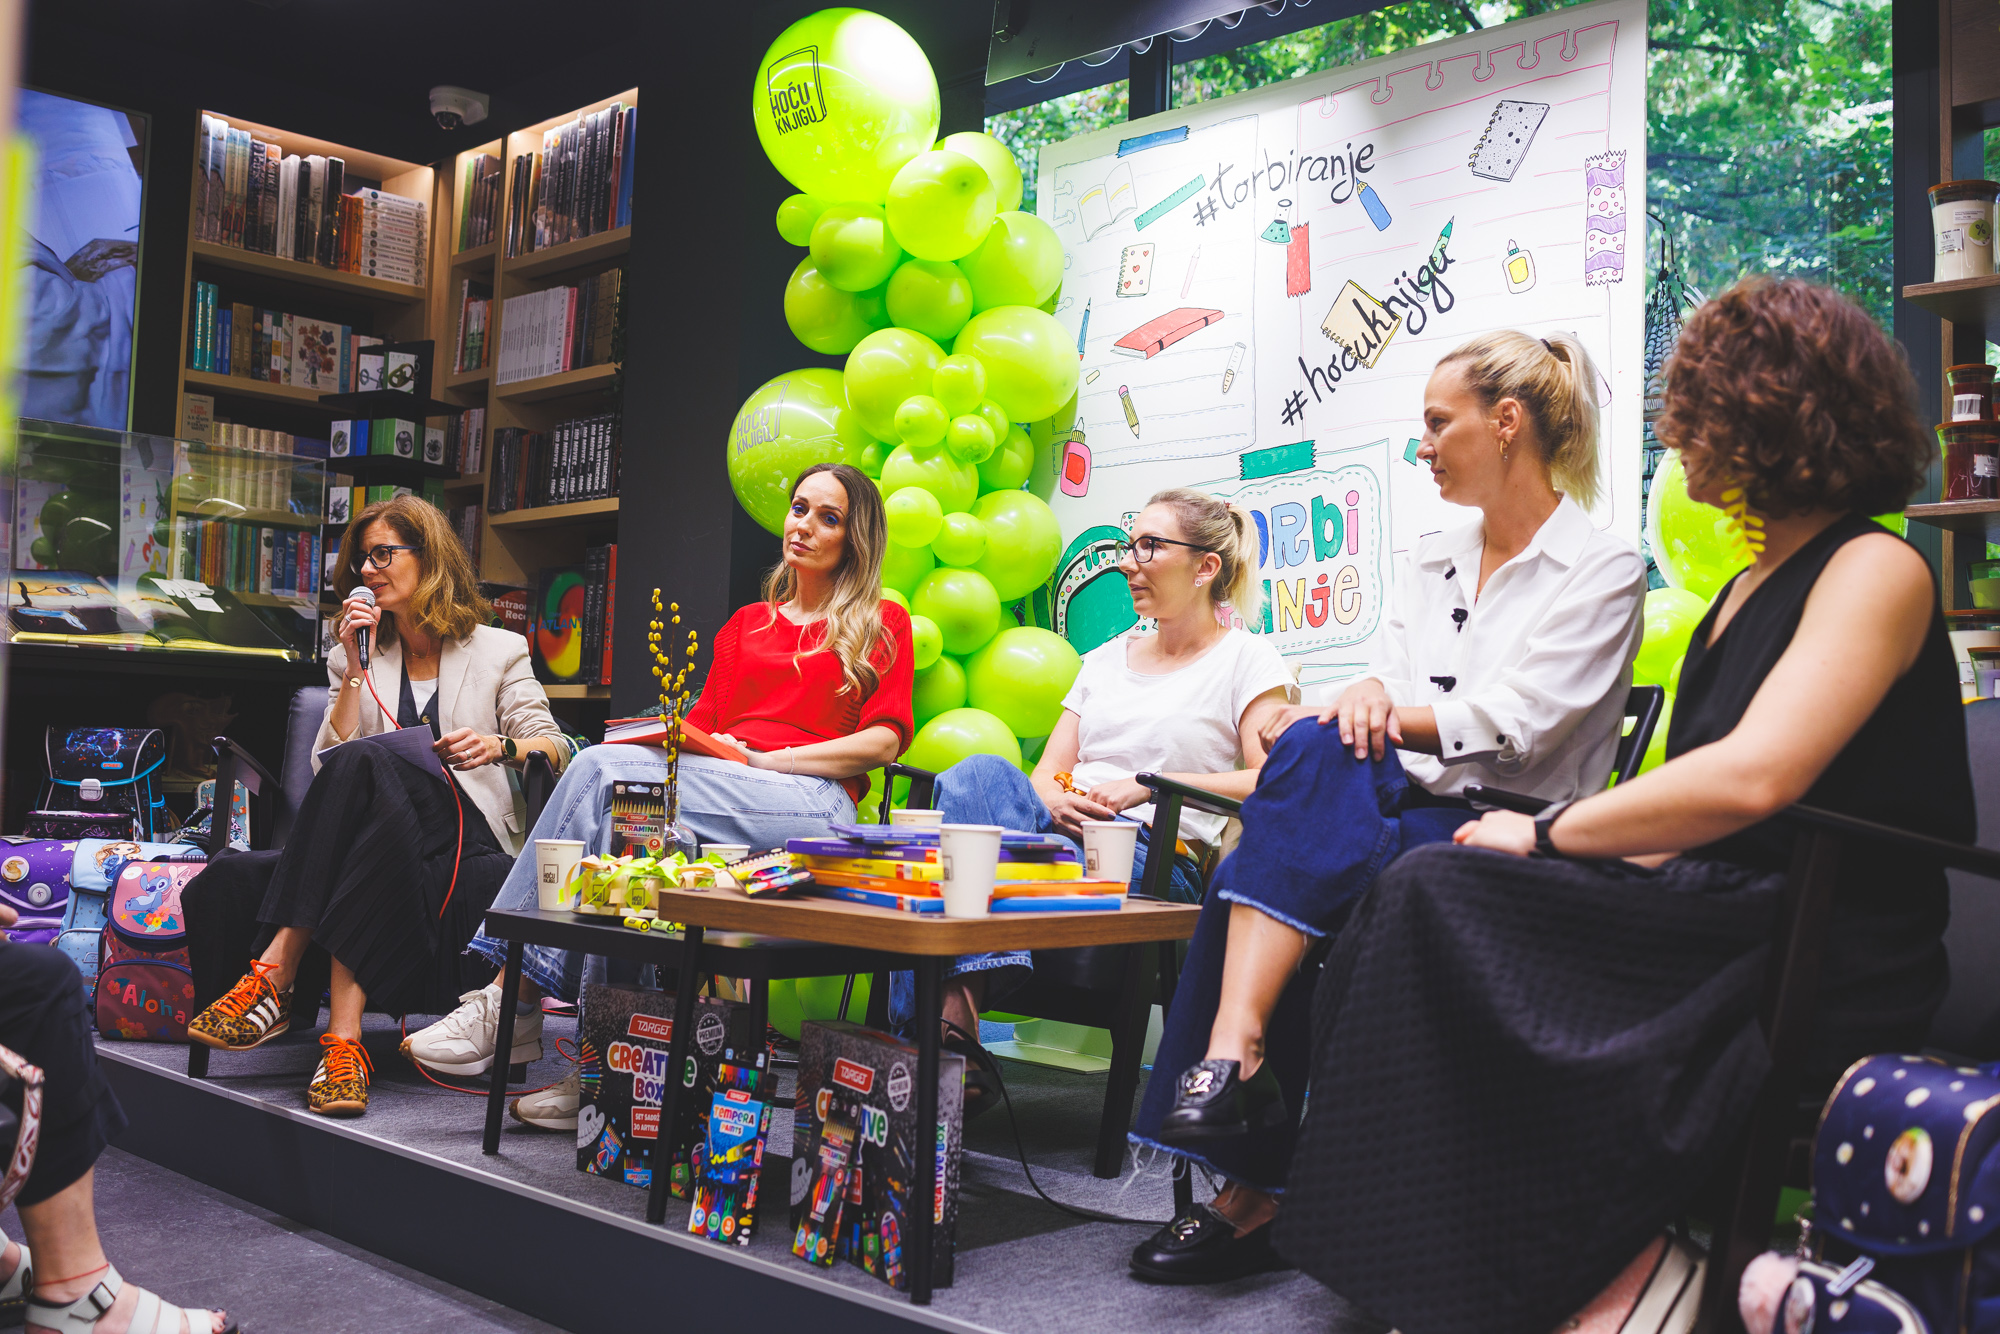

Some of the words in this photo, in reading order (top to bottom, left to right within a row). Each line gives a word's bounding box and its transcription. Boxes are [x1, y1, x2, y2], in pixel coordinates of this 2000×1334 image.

[769, 81, 811, 119] HOĆU
[774, 105, 818, 136] KNJIGU
[1192, 140, 1376, 228] #torbiranje
[1281, 242, 1457, 427] #hocuknjigu
[736, 406, 770, 440] HOĆU
[552, 442, 560, 468] MOVIES
[588, 436, 596, 462] MOVIES
[736, 425, 770, 456] KNJIGU
[593, 450, 602, 491] HITCHCOCK
[601, 449, 610, 490] HITCHCOCK
[265, 559, 273, 578] 100
[273, 546, 285, 579] Design
[584, 584, 594, 649] Motorcycles
[592, 584, 603, 648] Motorcycles
[615, 824, 659, 833] EXTRAMINA
[543, 871, 556, 879] HOĆU
[121, 983, 186, 1025] Aloha
[637, 1019, 671, 1036] TARGET
[699, 1026, 722, 1042] PREMIUM
[633, 1076, 665, 1106] BOX
[840, 1065, 868, 1086] TARGET
[633, 1123, 640, 1131] 30
[635, 1112, 644, 1120] SET
[936, 1120, 948, 1151] BOX
